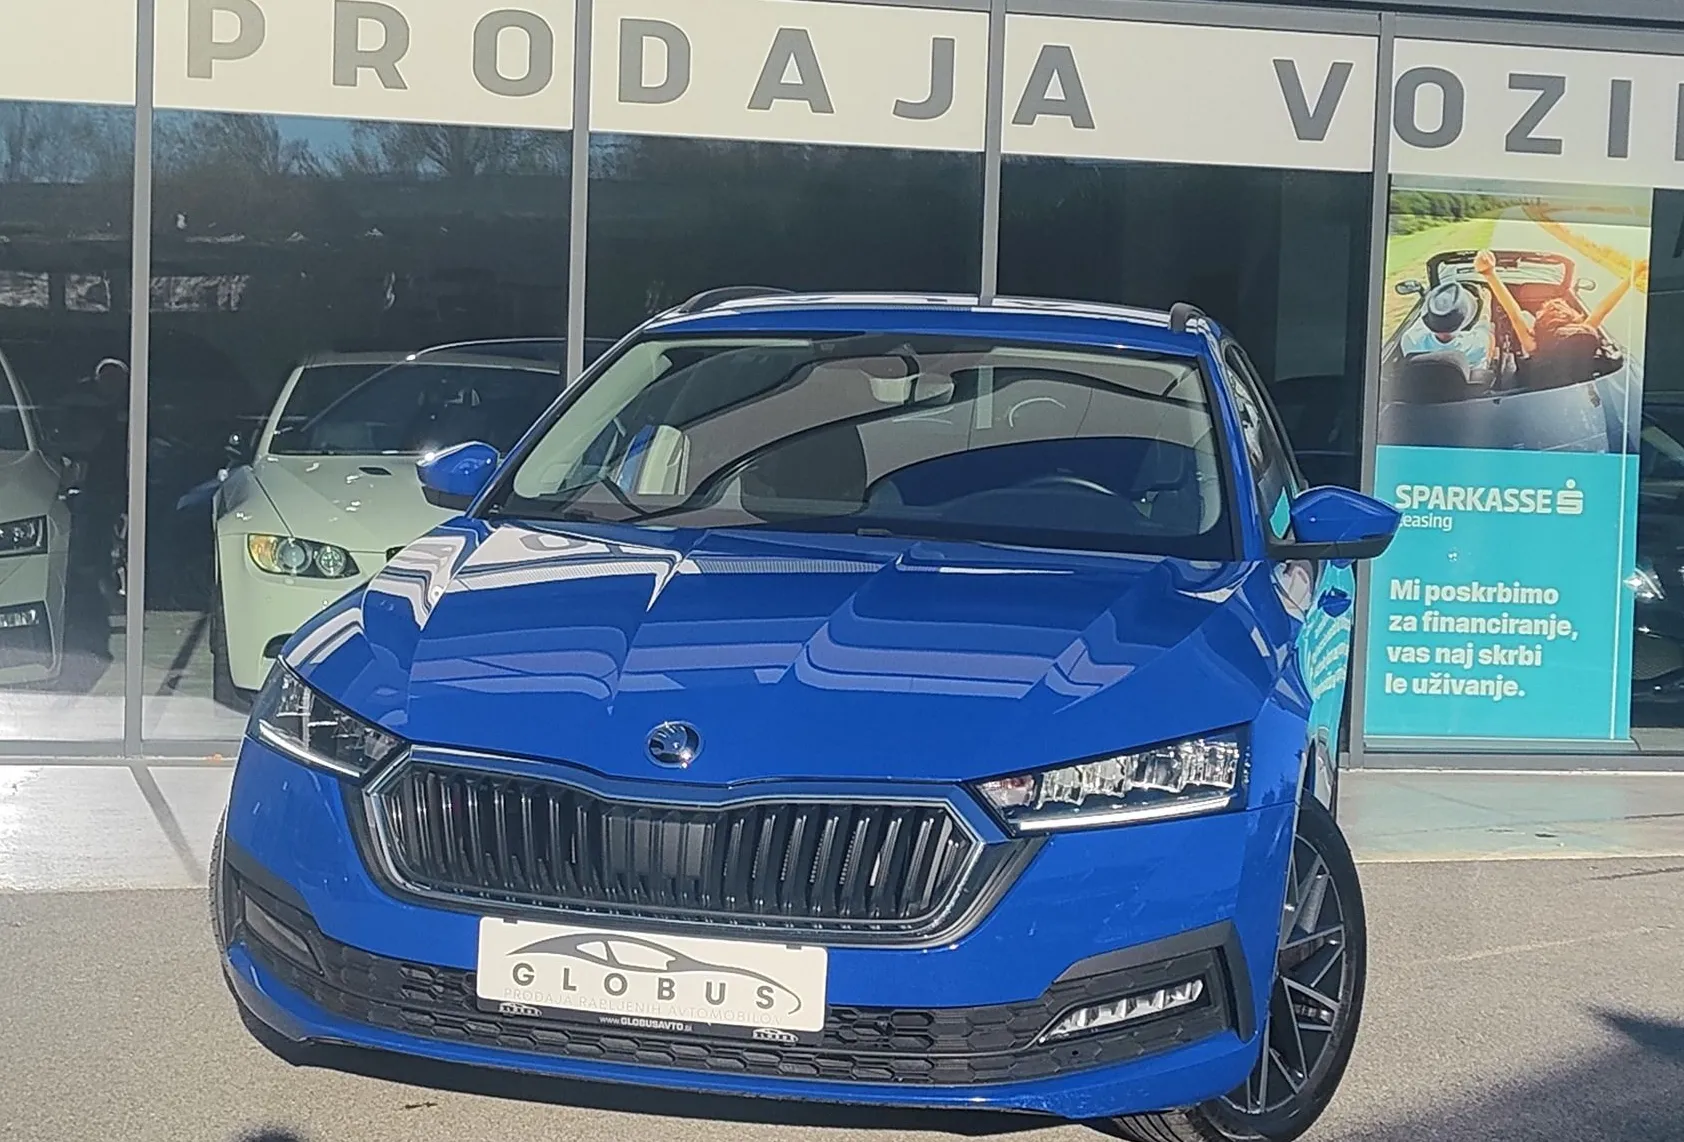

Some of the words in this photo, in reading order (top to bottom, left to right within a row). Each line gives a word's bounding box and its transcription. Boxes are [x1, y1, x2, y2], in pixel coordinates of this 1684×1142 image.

[187, 0, 1095, 129] PRODAJA
[1273, 59, 1684, 161] VOZI
[1395, 484, 1552, 514] SPARKASSE
[1390, 578, 1420, 601] Mi
[1425, 581, 1559, 605] poskrbimo
[1389, 614, 1417, 632] za
[1422, 611, 1578, 641] financiranje,
[1387, 645, 1430, 664] vas
[1434, 642, 1474, 669] naj
[1478, 644, 1542, 667] skrbi
[1385, 672, 1408, 694] le
[1412, 672, 1525, 701] uživanje.
[504, 987, 573, 1006] PRODAJA
[512, 962, 774, 1010] GLOBUS
